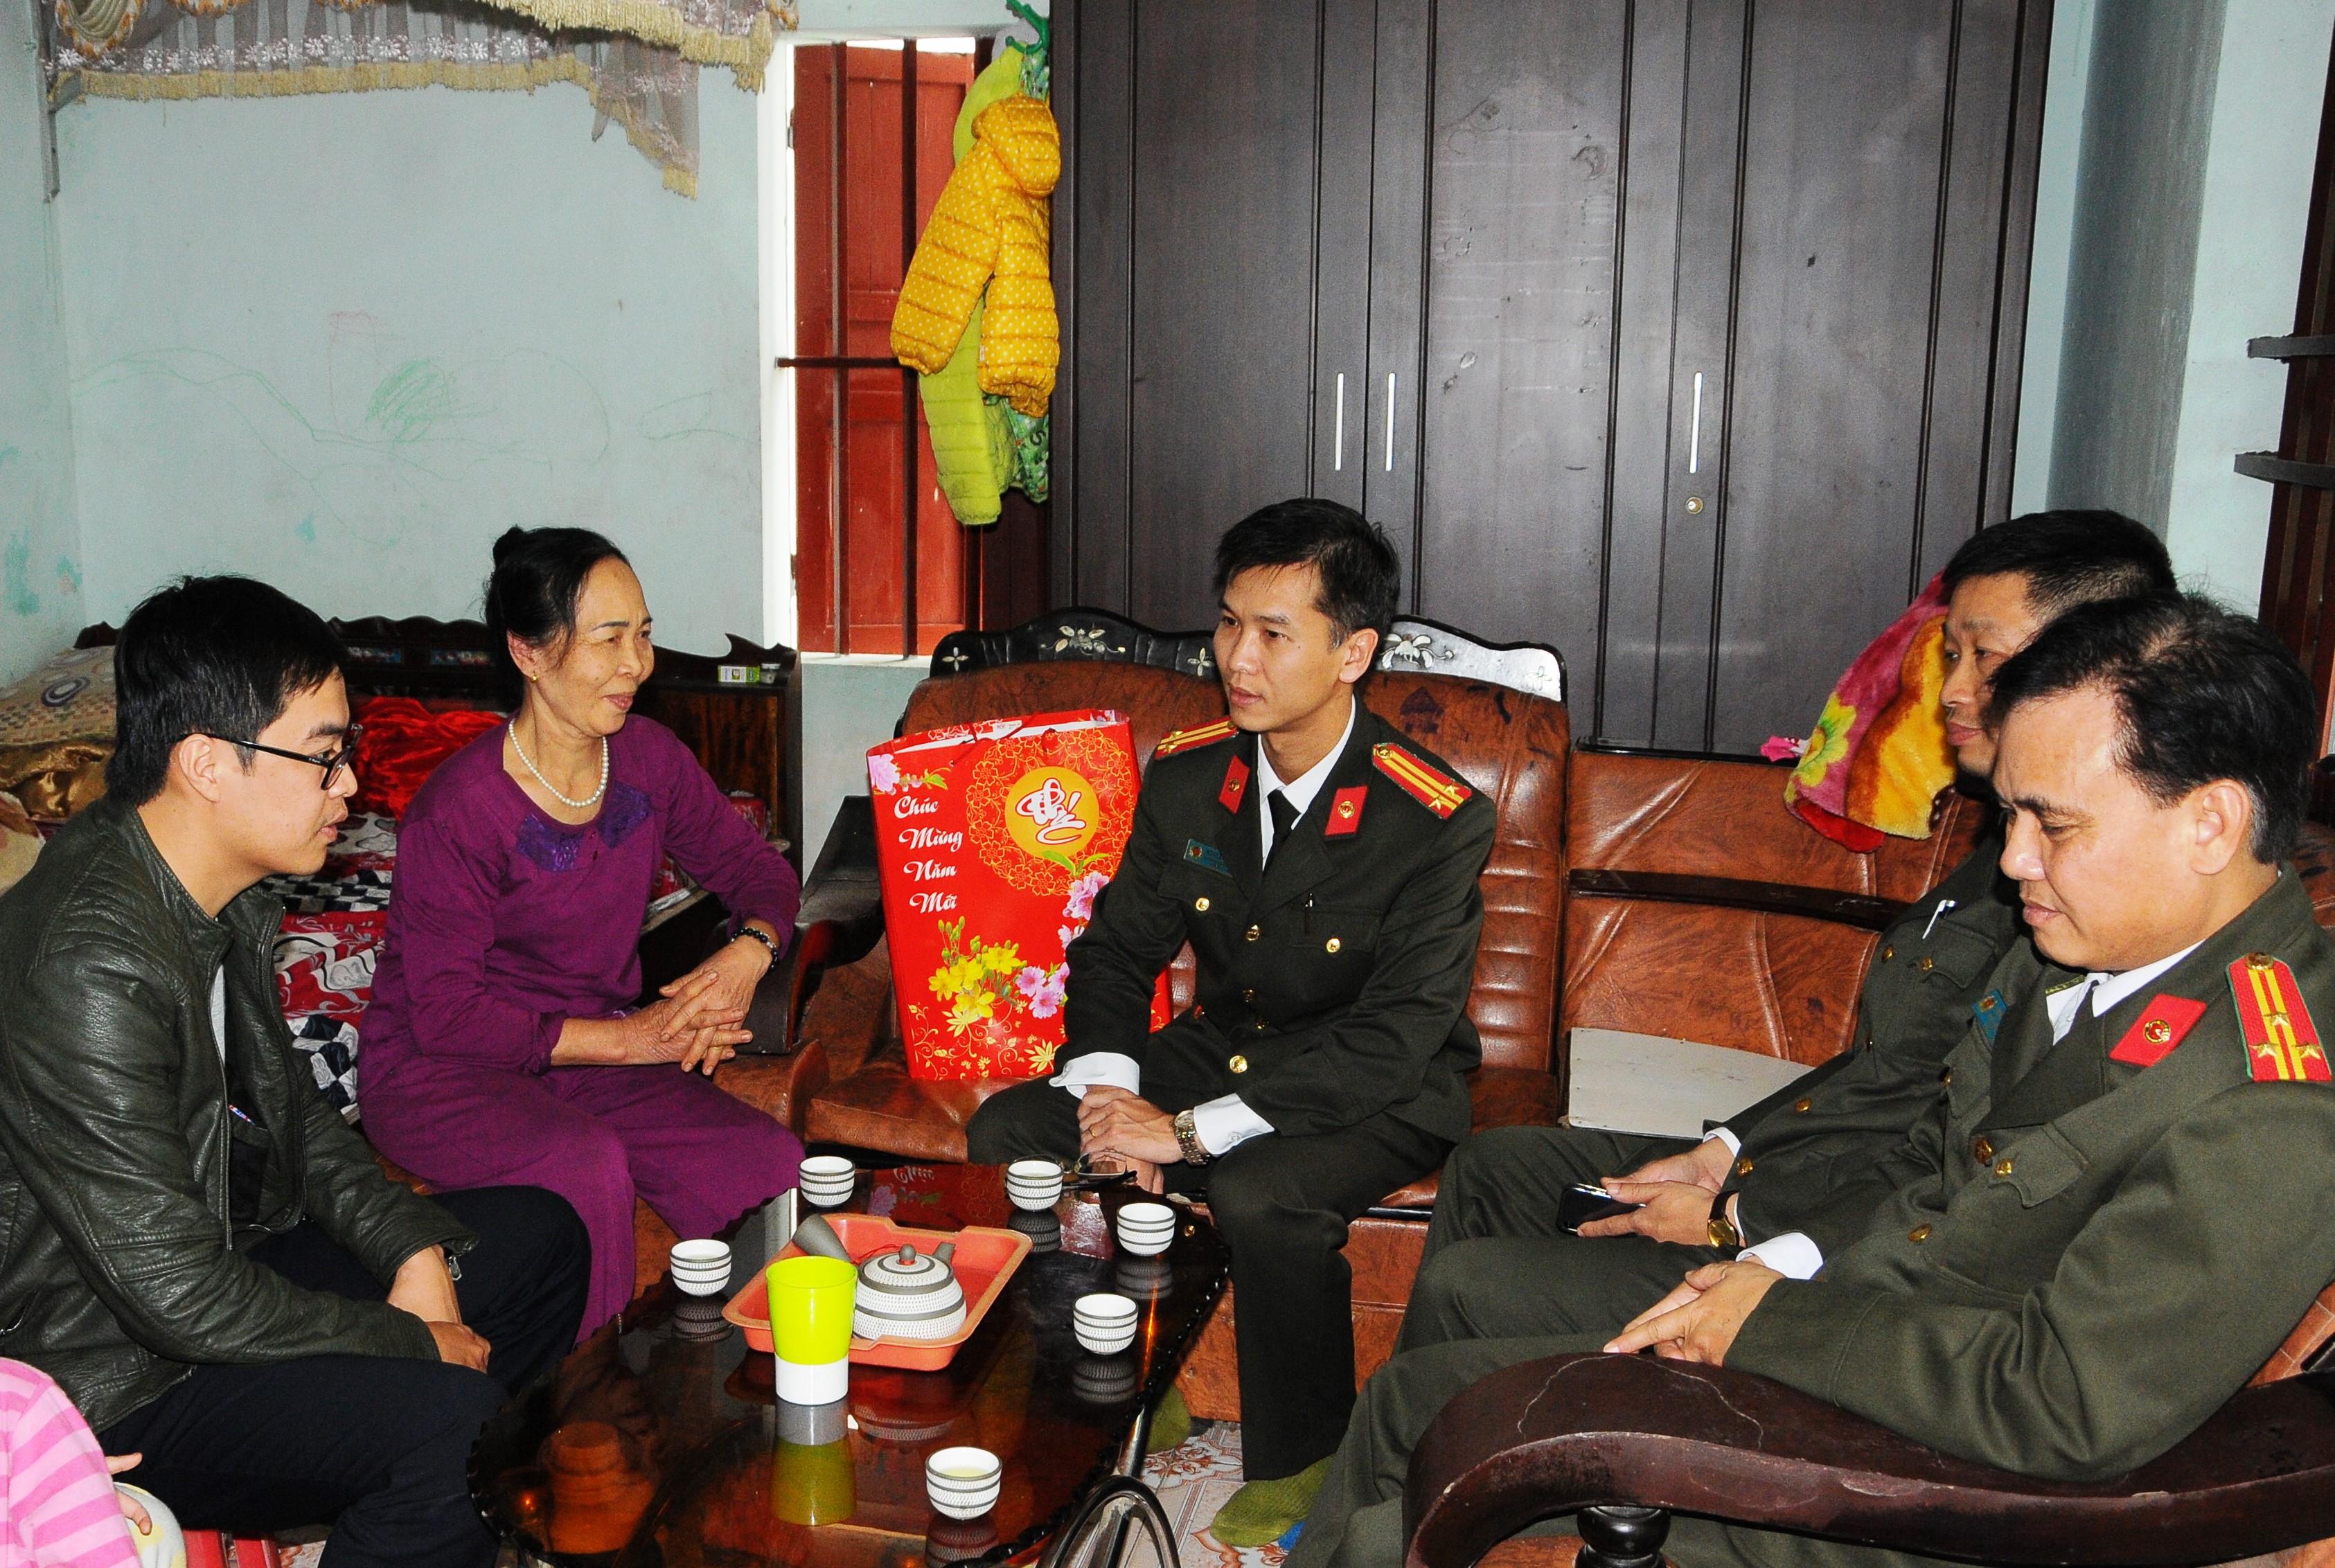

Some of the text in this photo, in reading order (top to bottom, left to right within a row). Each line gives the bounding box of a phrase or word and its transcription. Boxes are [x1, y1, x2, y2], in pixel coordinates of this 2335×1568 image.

[894, 795, 939, 819] Chúc
[898, 827, 964, 853] Mừng
[903, 859, 957, 882] Năm
[909, 891, 957, 914] Mới
